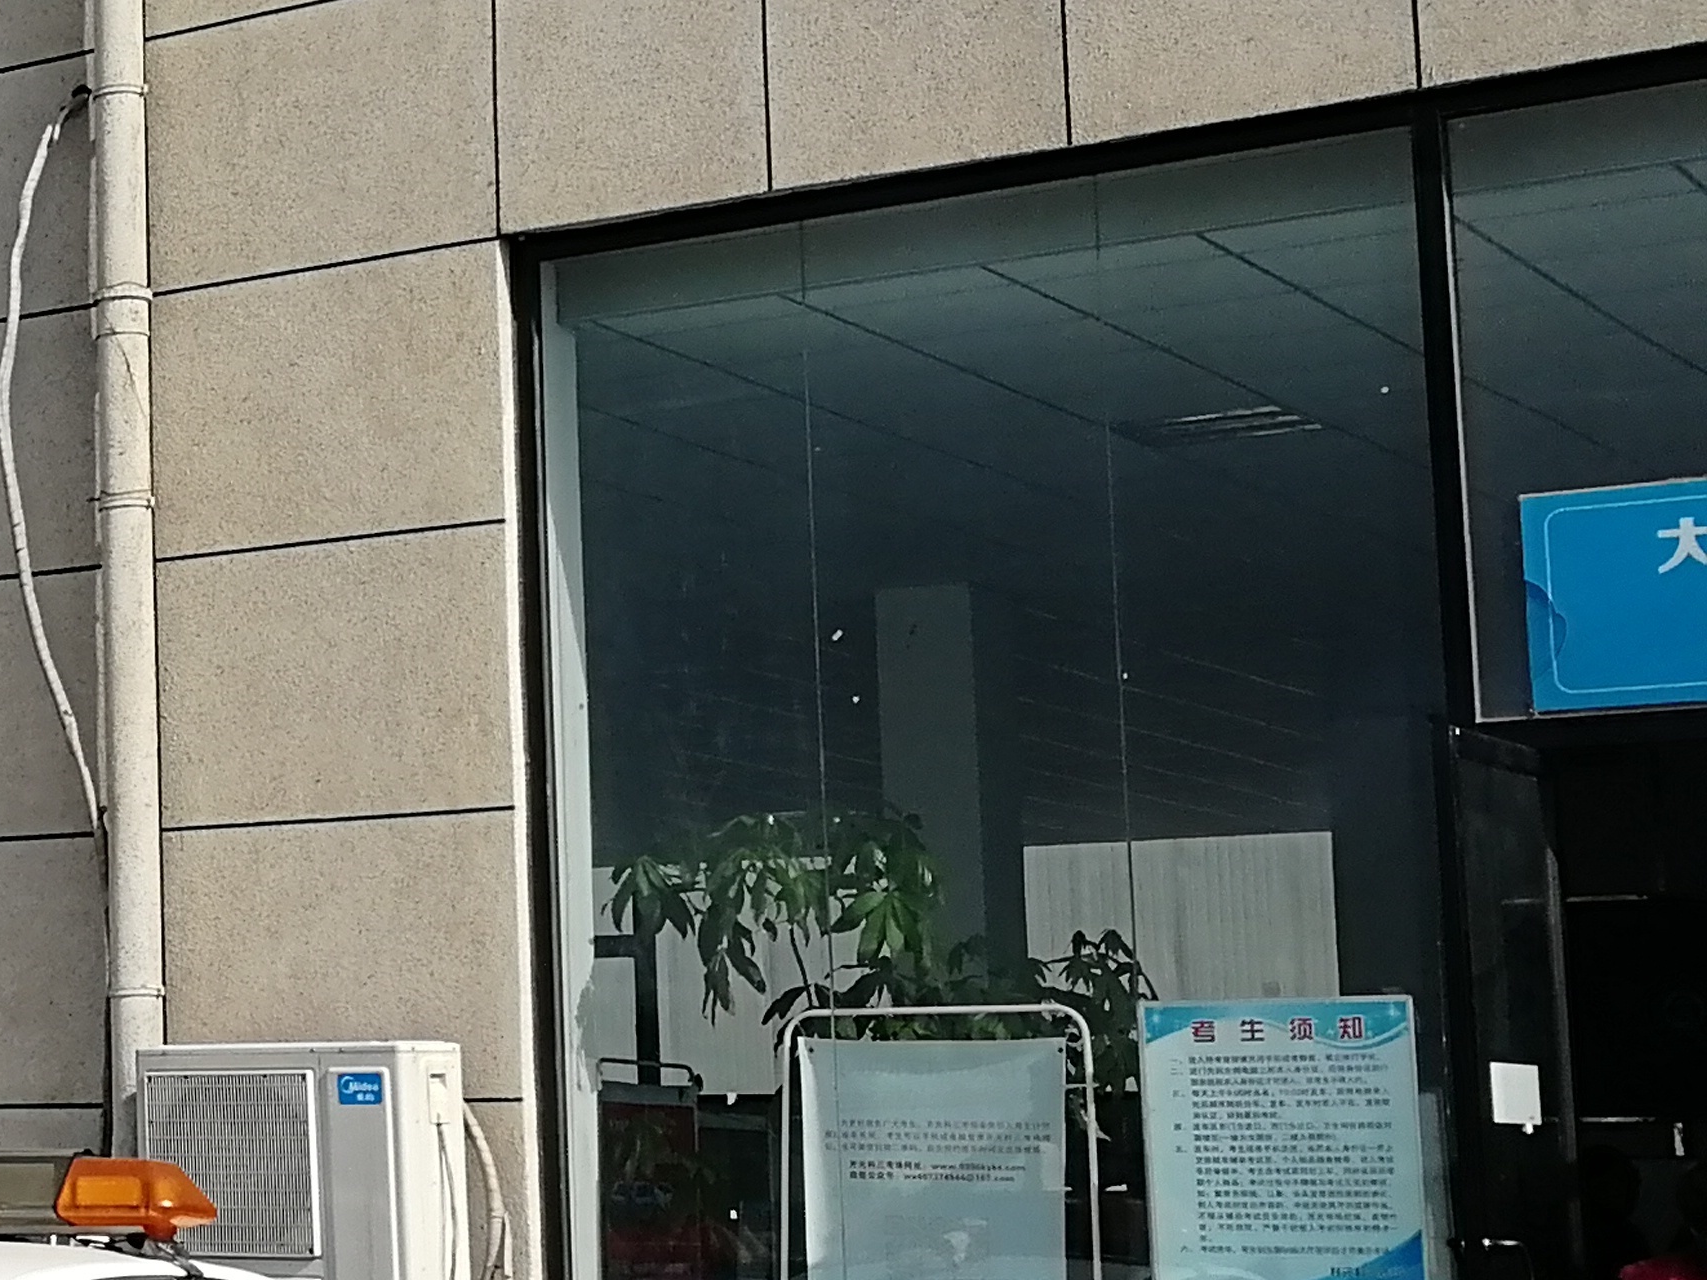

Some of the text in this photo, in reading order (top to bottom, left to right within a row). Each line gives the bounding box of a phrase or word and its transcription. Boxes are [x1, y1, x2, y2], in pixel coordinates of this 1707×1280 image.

[1657, 516, 1707, 575] 大
[1190, 1016, 1365, 1044] 考生须知
